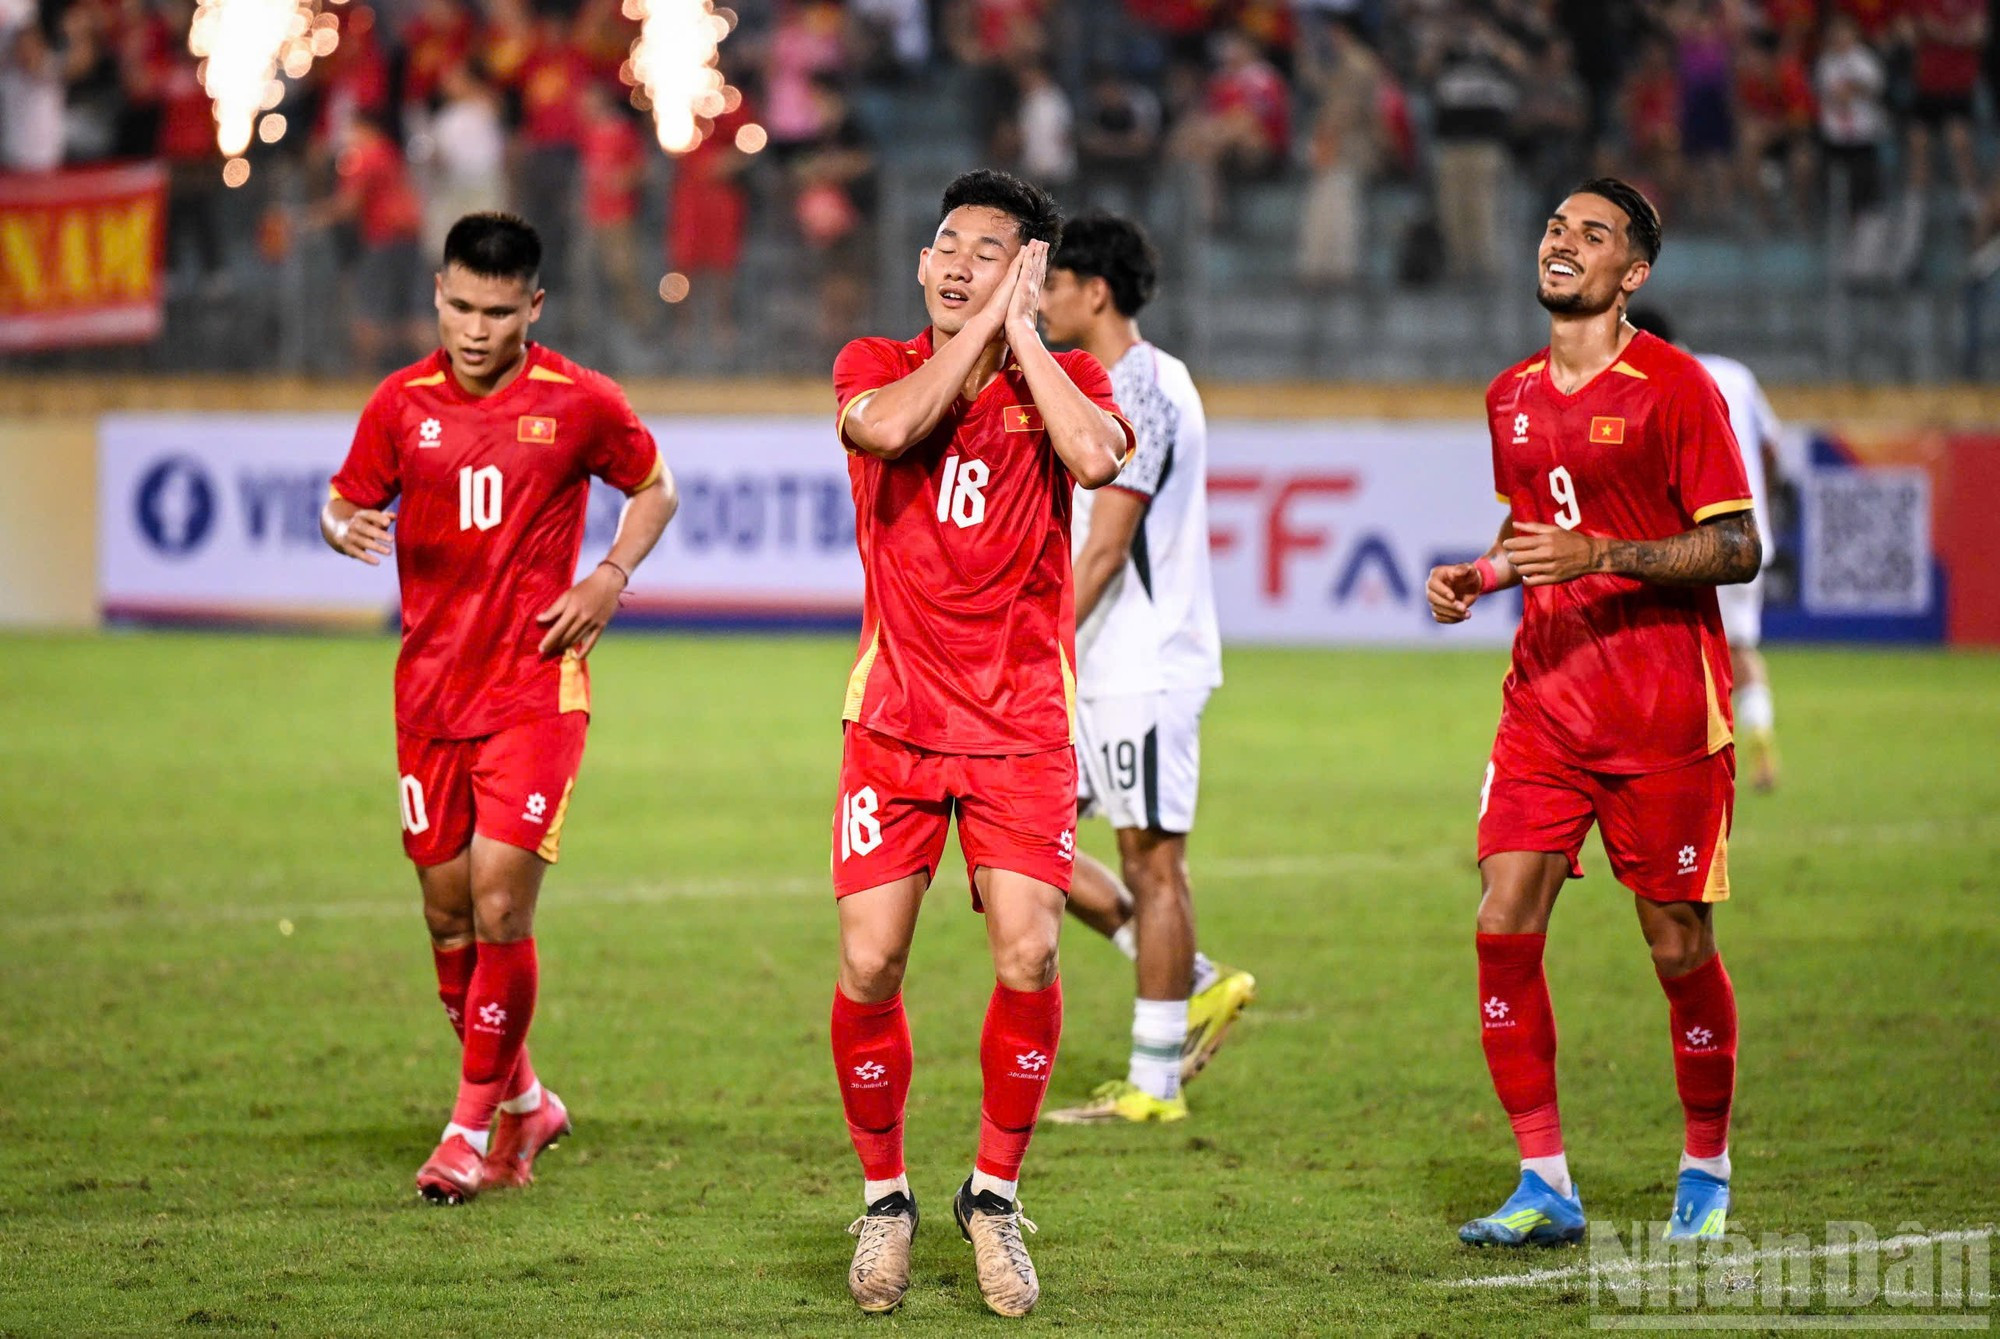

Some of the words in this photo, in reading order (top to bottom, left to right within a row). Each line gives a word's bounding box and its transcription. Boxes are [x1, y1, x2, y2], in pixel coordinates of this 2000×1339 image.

[459, 464, 503, 532] 10
[936, 454, 990, 529] 18
[1548, 465, 1582, 531] 9
[1100, 740, 1137, 790] 19
[399, 774, 430, 836] 0
[841, 785, 884, 863] 18
